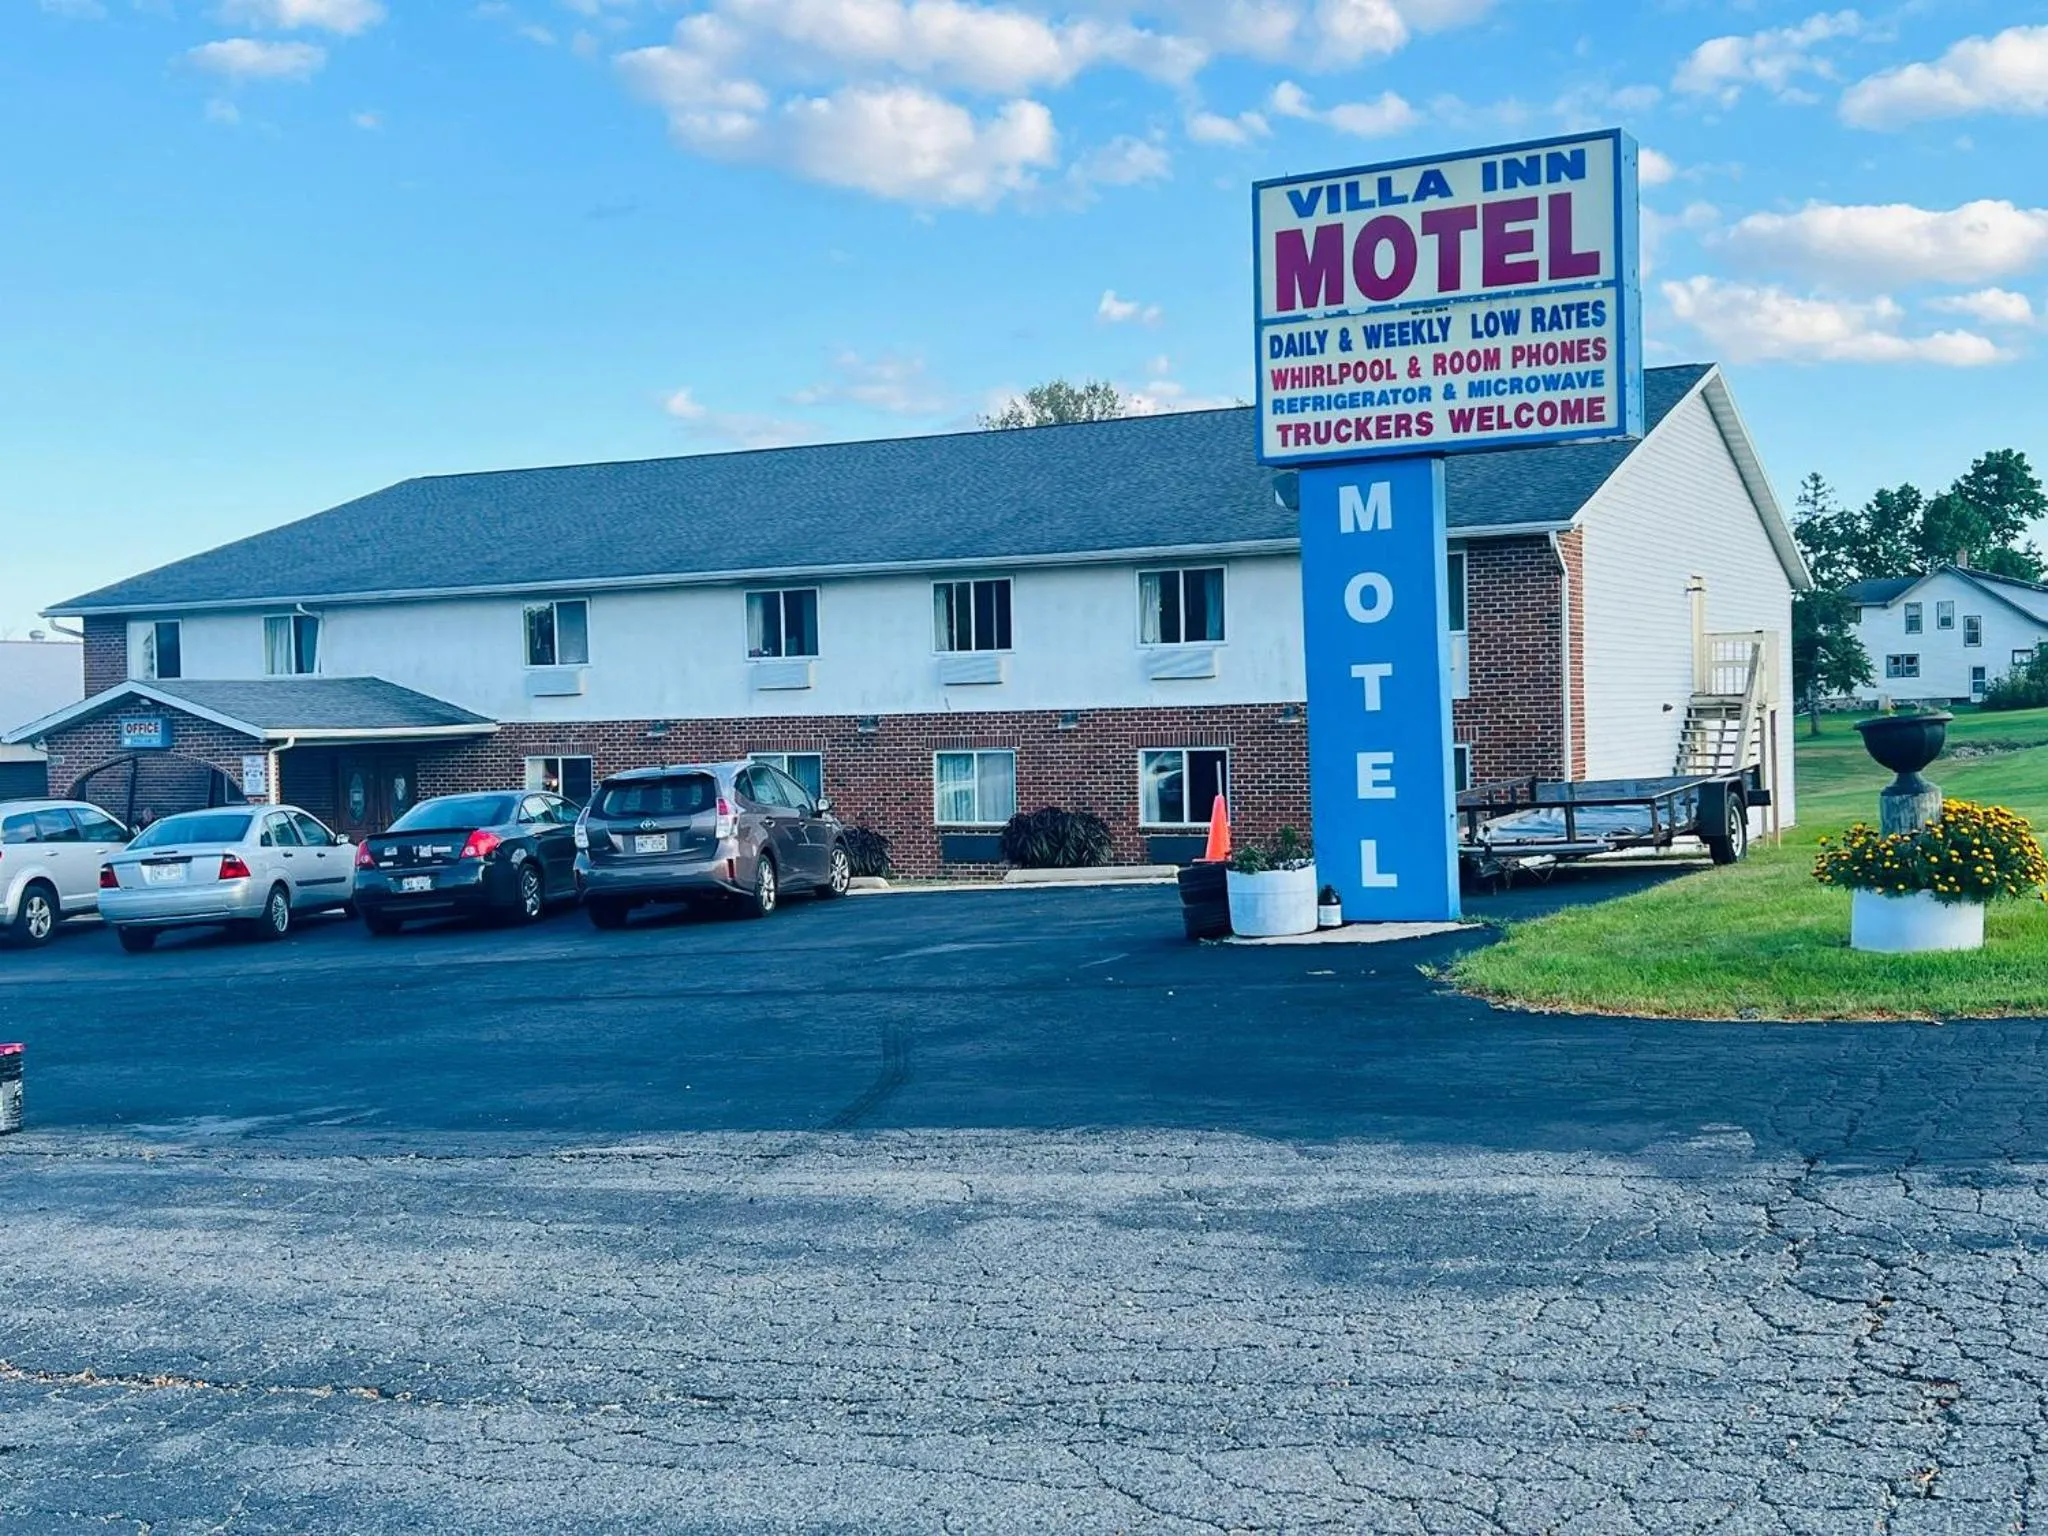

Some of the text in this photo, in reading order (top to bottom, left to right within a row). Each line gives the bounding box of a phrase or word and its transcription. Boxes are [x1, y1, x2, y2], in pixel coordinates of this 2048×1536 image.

[1286, 148, 1586, 219] VILLA INN
[1275, 192, 1601, 313] MOTEL
[1269, 299, 1607, 360] DAILY & WEEKLY LOW RATES
[1270, 336, 1607, 391] WHIRLPOOL & ROOM PHONES
[1271, 369, 1605, 416] REFRIGERATOR & MICROWAVE
[1276, 396, 1606, 448] TRUCKERS WELCOME
[1338, 481, 1398, 888] MOTEL
[126, 721, 160, 734] OFFICE
